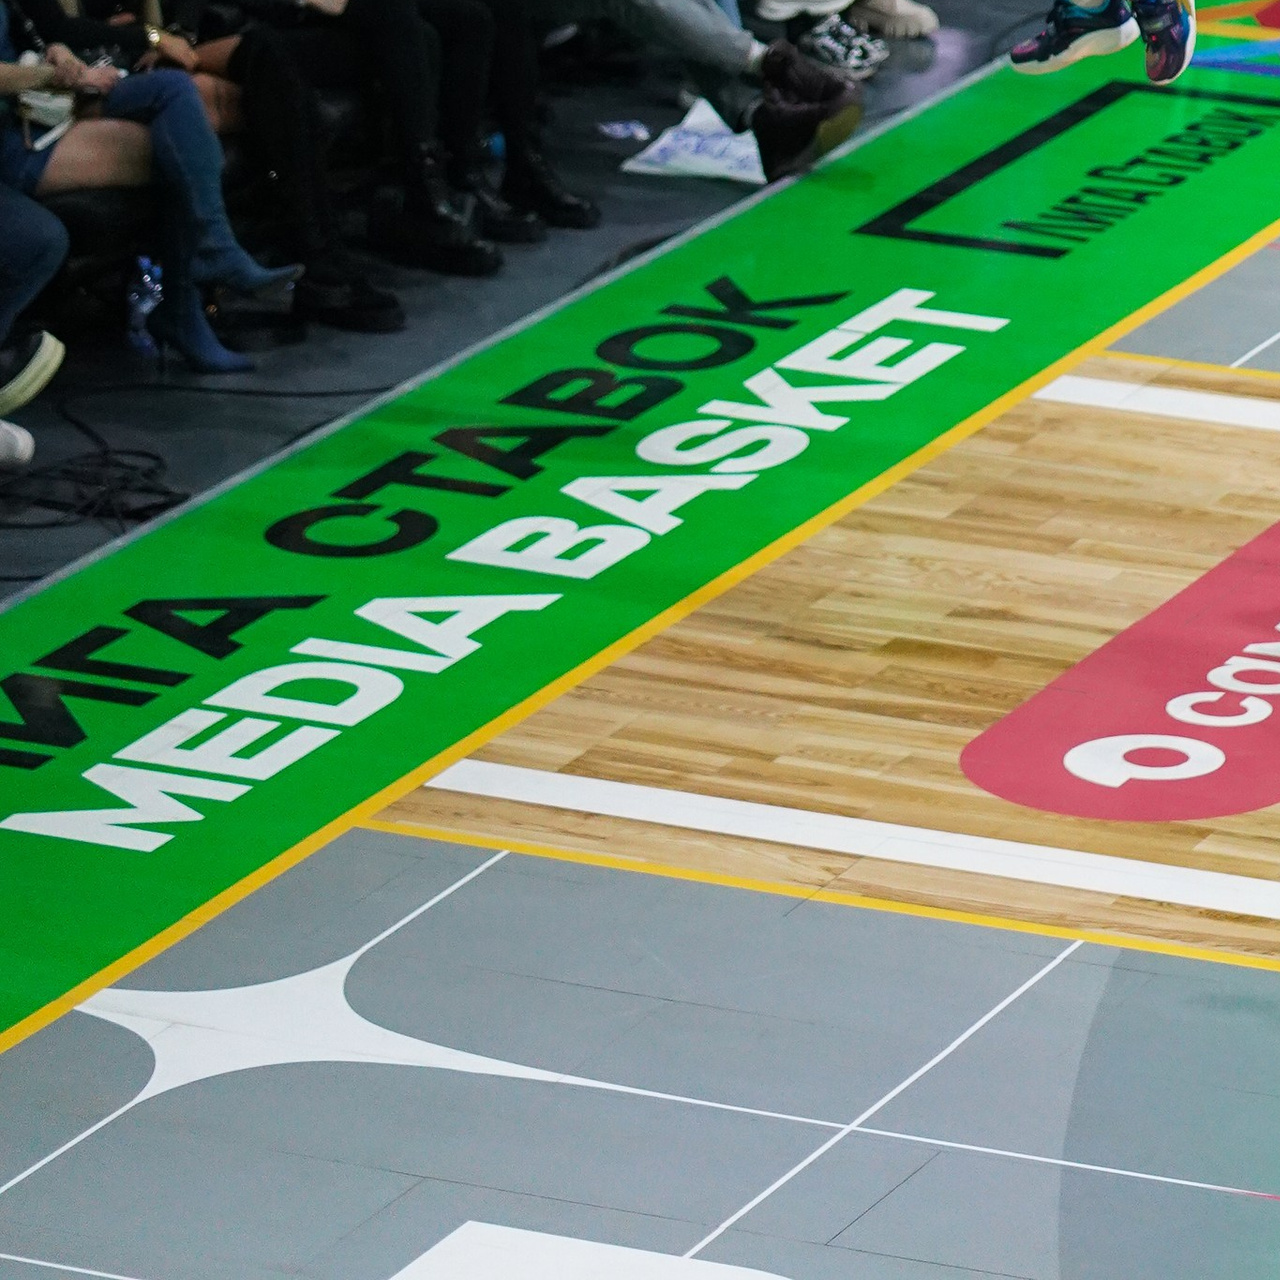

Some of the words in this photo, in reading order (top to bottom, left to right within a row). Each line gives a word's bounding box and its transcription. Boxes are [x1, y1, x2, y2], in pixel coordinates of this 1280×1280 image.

[0, 593, 331, 771] ИГА
[264, 275, 854, 558] СТАВОК
[0, 593, 564, 853] MEDIA
[445, 288, 1011, 580] BASKET
